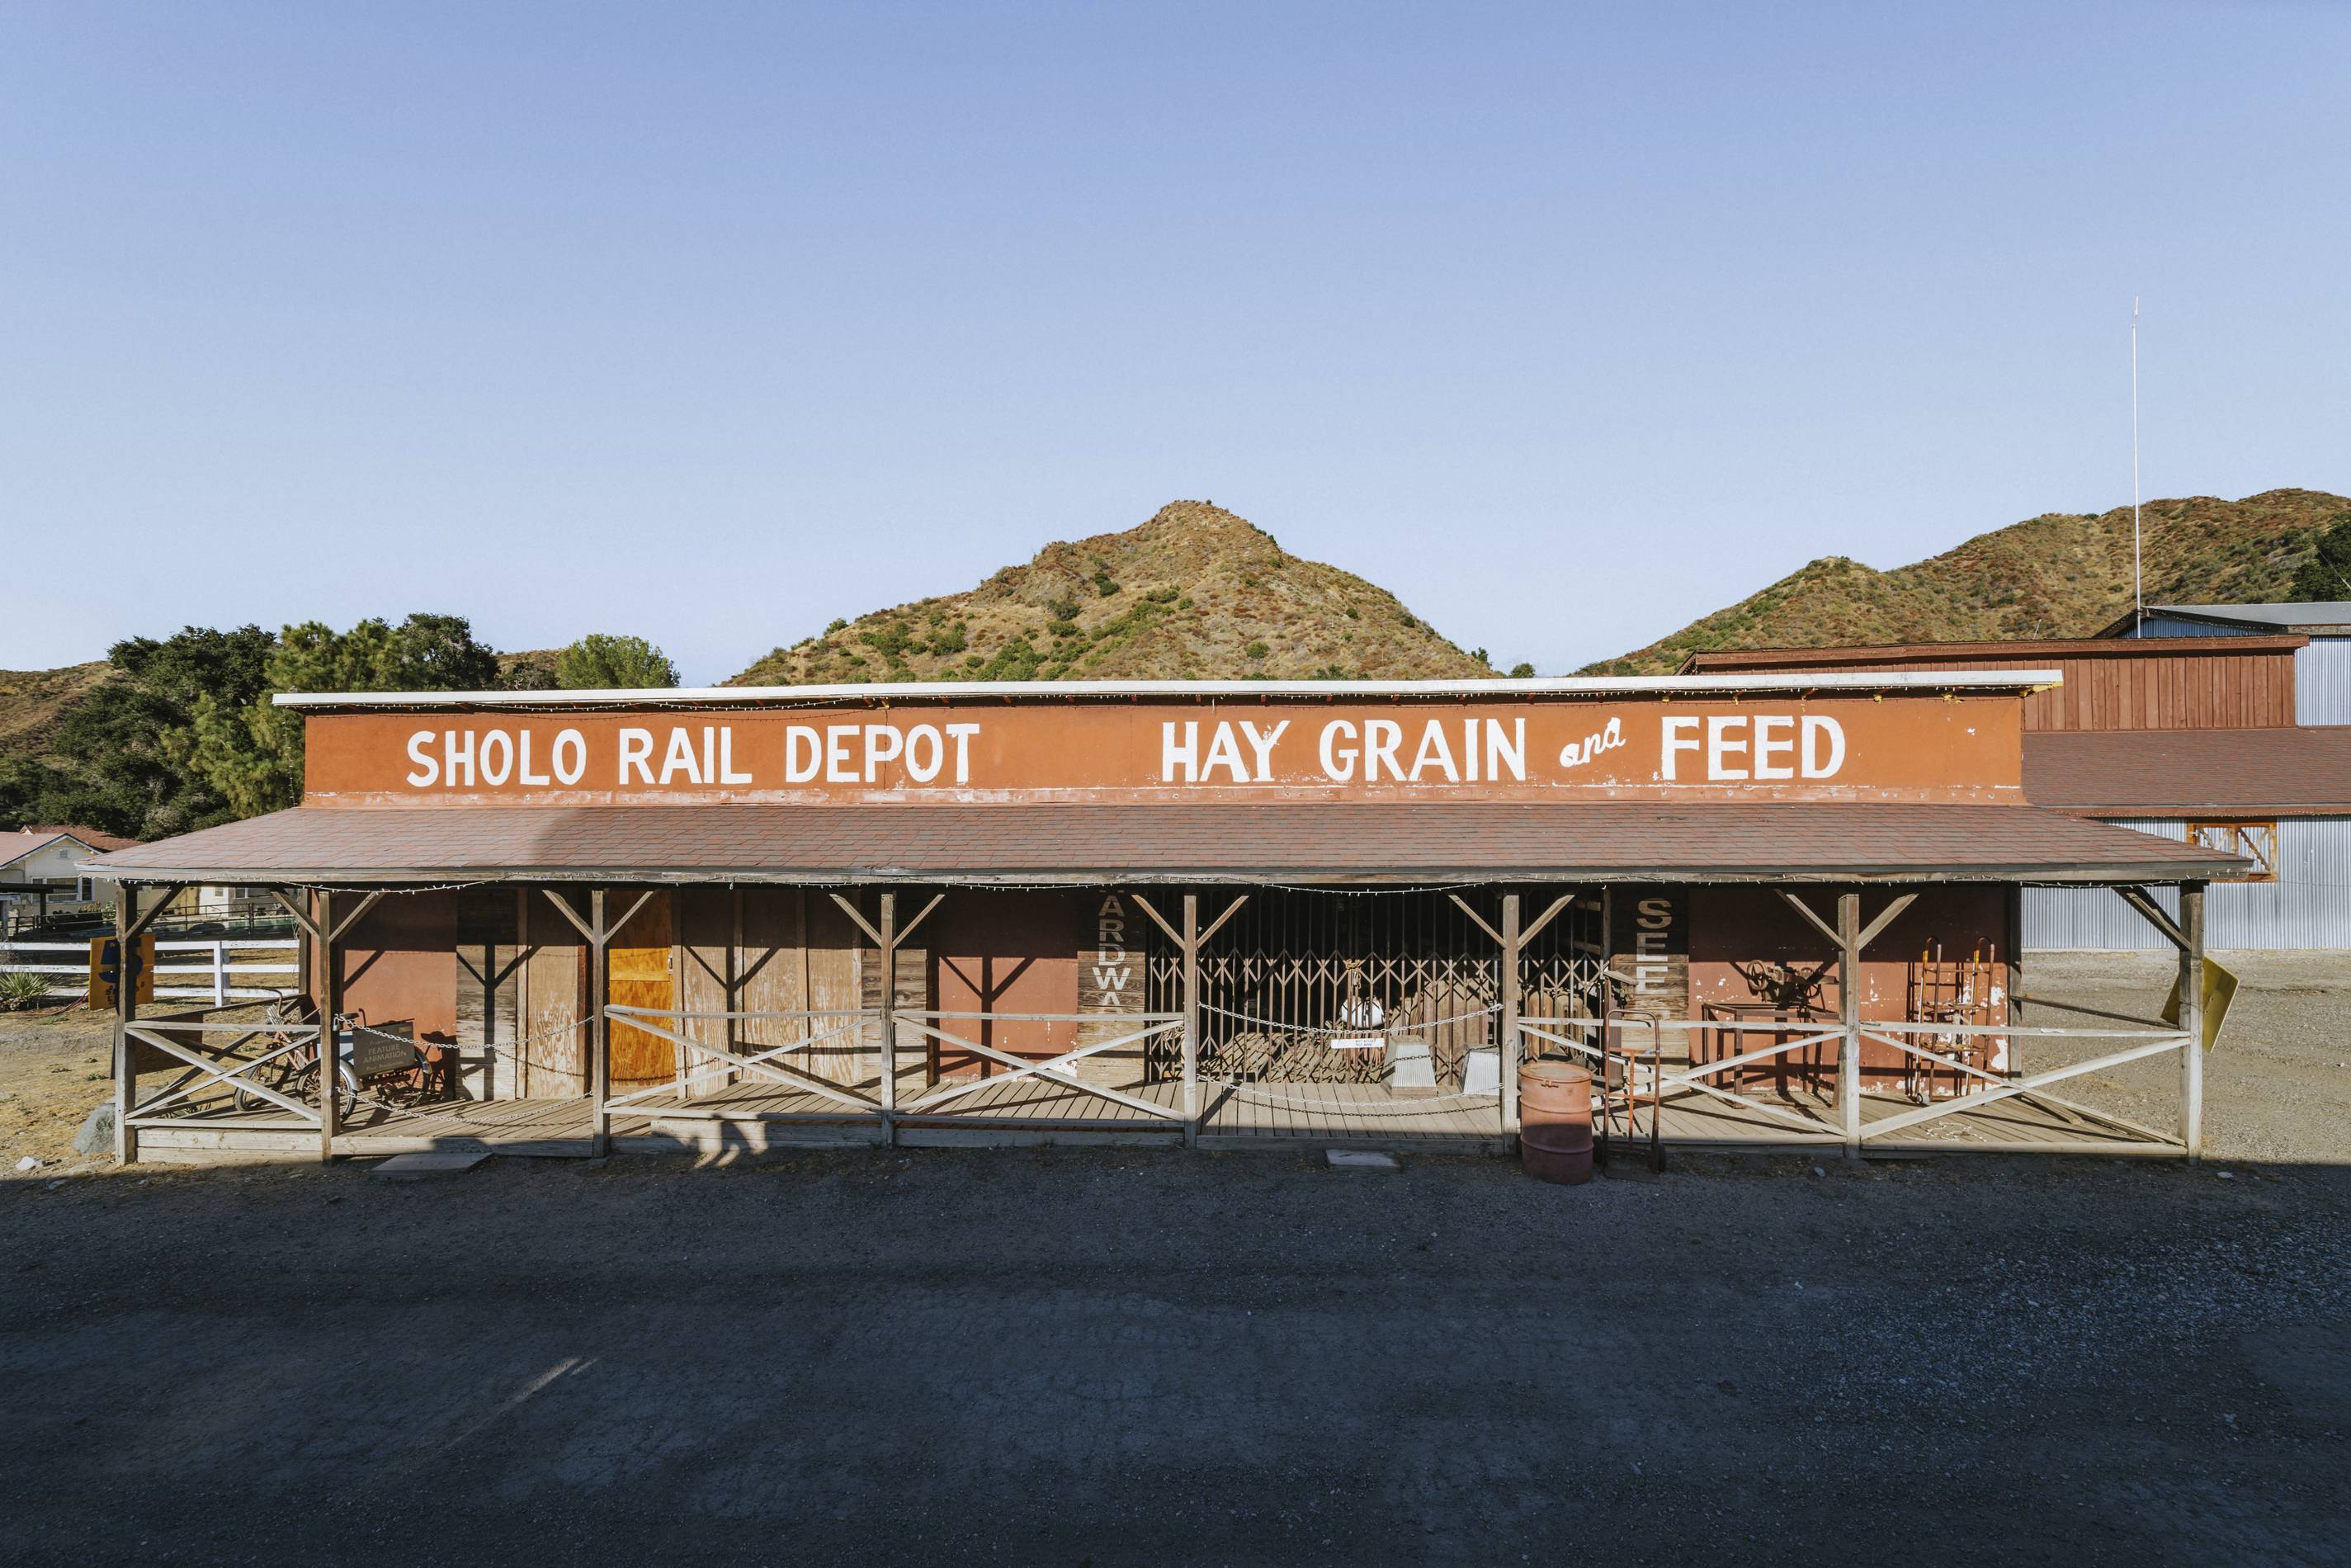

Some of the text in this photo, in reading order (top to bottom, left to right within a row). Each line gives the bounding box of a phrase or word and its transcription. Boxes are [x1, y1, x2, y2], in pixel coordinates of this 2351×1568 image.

[406, 723, 980, 787] SHOLO RAIL DEPOT
[1161, 715, 1846, 785] HAY GRAIN and FEED
[1092, 890, 1131, 1014] ARDWA
[363, 1050, 407, 1064] ANIMATION
[368, 1043, 400, 1056] FEATURE
